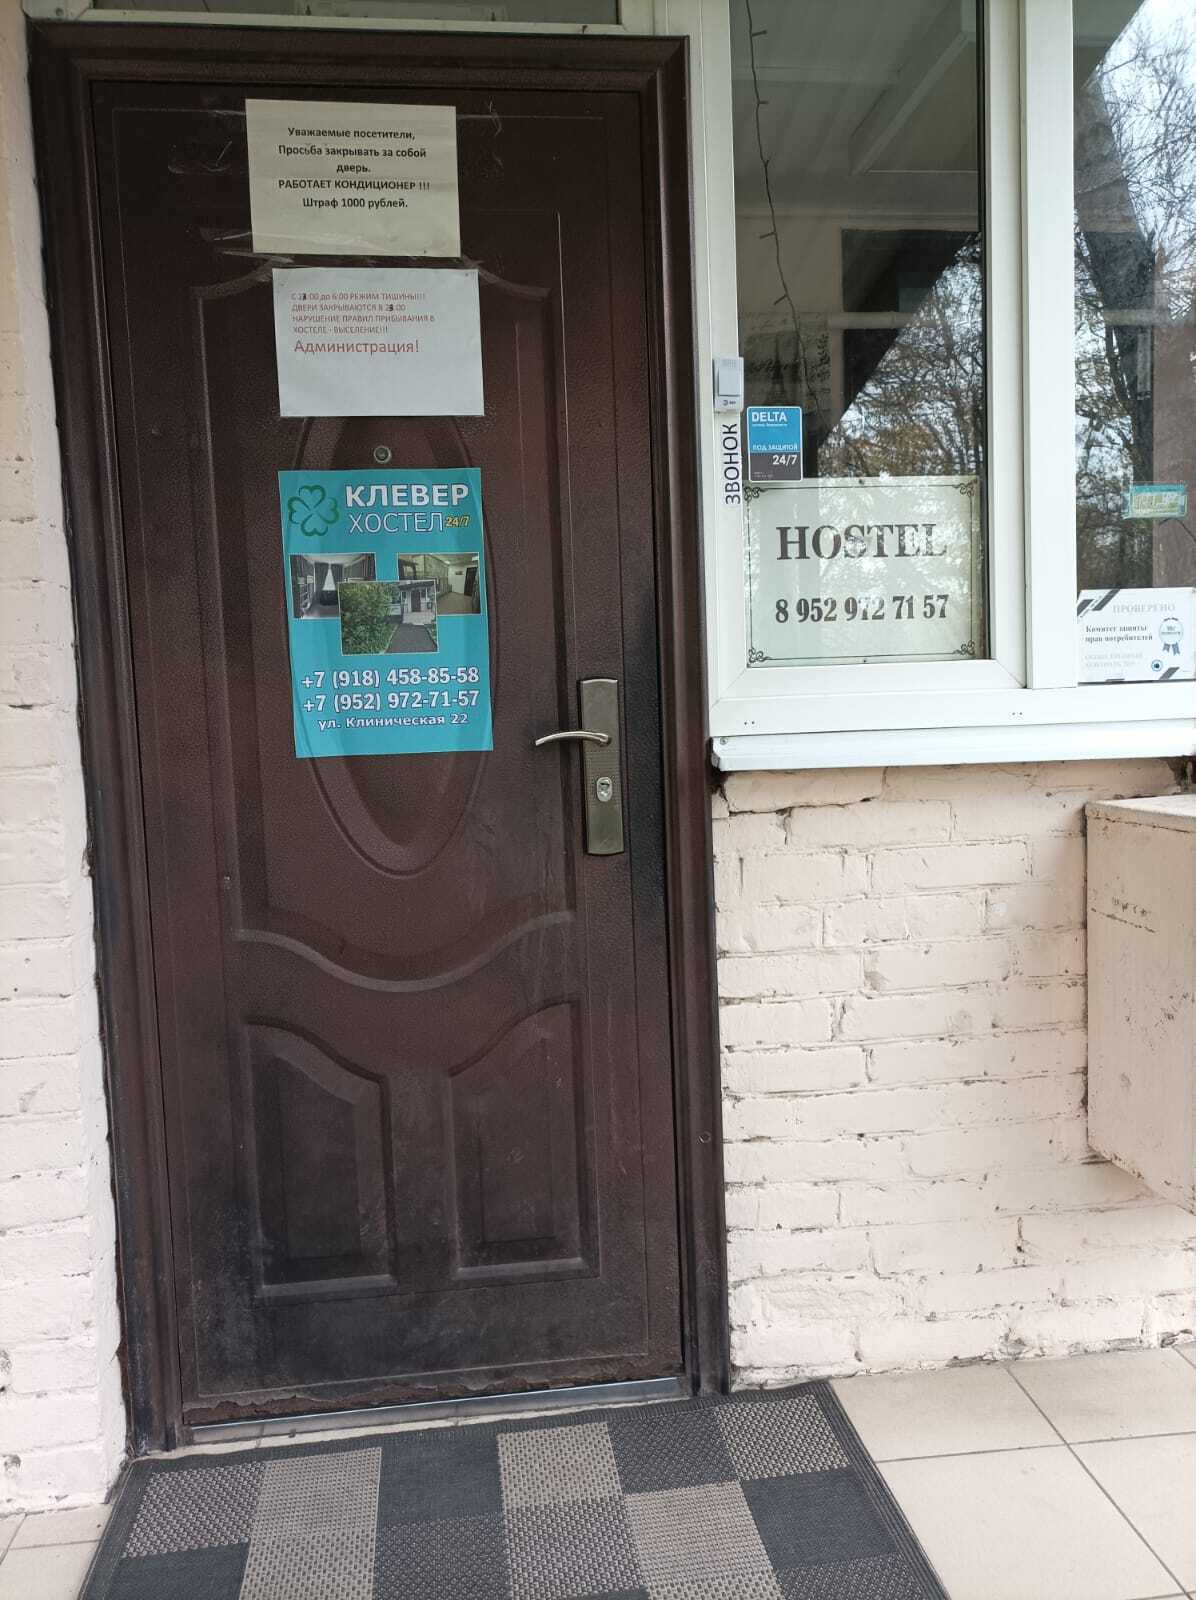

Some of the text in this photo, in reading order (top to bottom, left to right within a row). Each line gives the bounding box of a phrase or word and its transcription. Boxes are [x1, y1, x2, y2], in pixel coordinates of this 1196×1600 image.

[288, 127, 415, 140] Уважаемые посетители,
[278, 144, 427, 157] Просьба закрывать за собой
[336, 164, 371, 174] дверь.
[278, 179, 331, 189] РАБОТАЕТ
[334, 180, 416, 191] КОНДИЦИОНЕР
[302, 197, 408, 210] Штраф 1000 рублей.
[350, 292, 380, 300] РЕЖИМ
[291, 303, 316, 312] ДВЕРИ
[294, 339, 420, 355] Администрация!
[752, 411, 788, 422] DELTA
[722, 423, 741, 505] ЗВОНОК
[772, 454, 798, 466] 24/7
[345, 483, 470, 508] КЛЕВЕР
[348, 512, 471, 533] ХОСТЕЛ 24/7
[775, 523, 948, 560] HOSTEL
[775, 594, 949, 623] 8 952 972 71 57
[302, 667, 480, 689] +7 (918) 458-85-58
[303, 690, 480, 712] +7 (952) 972-71-57
[318, 713, 468, 730] ул. Клиническая 22
